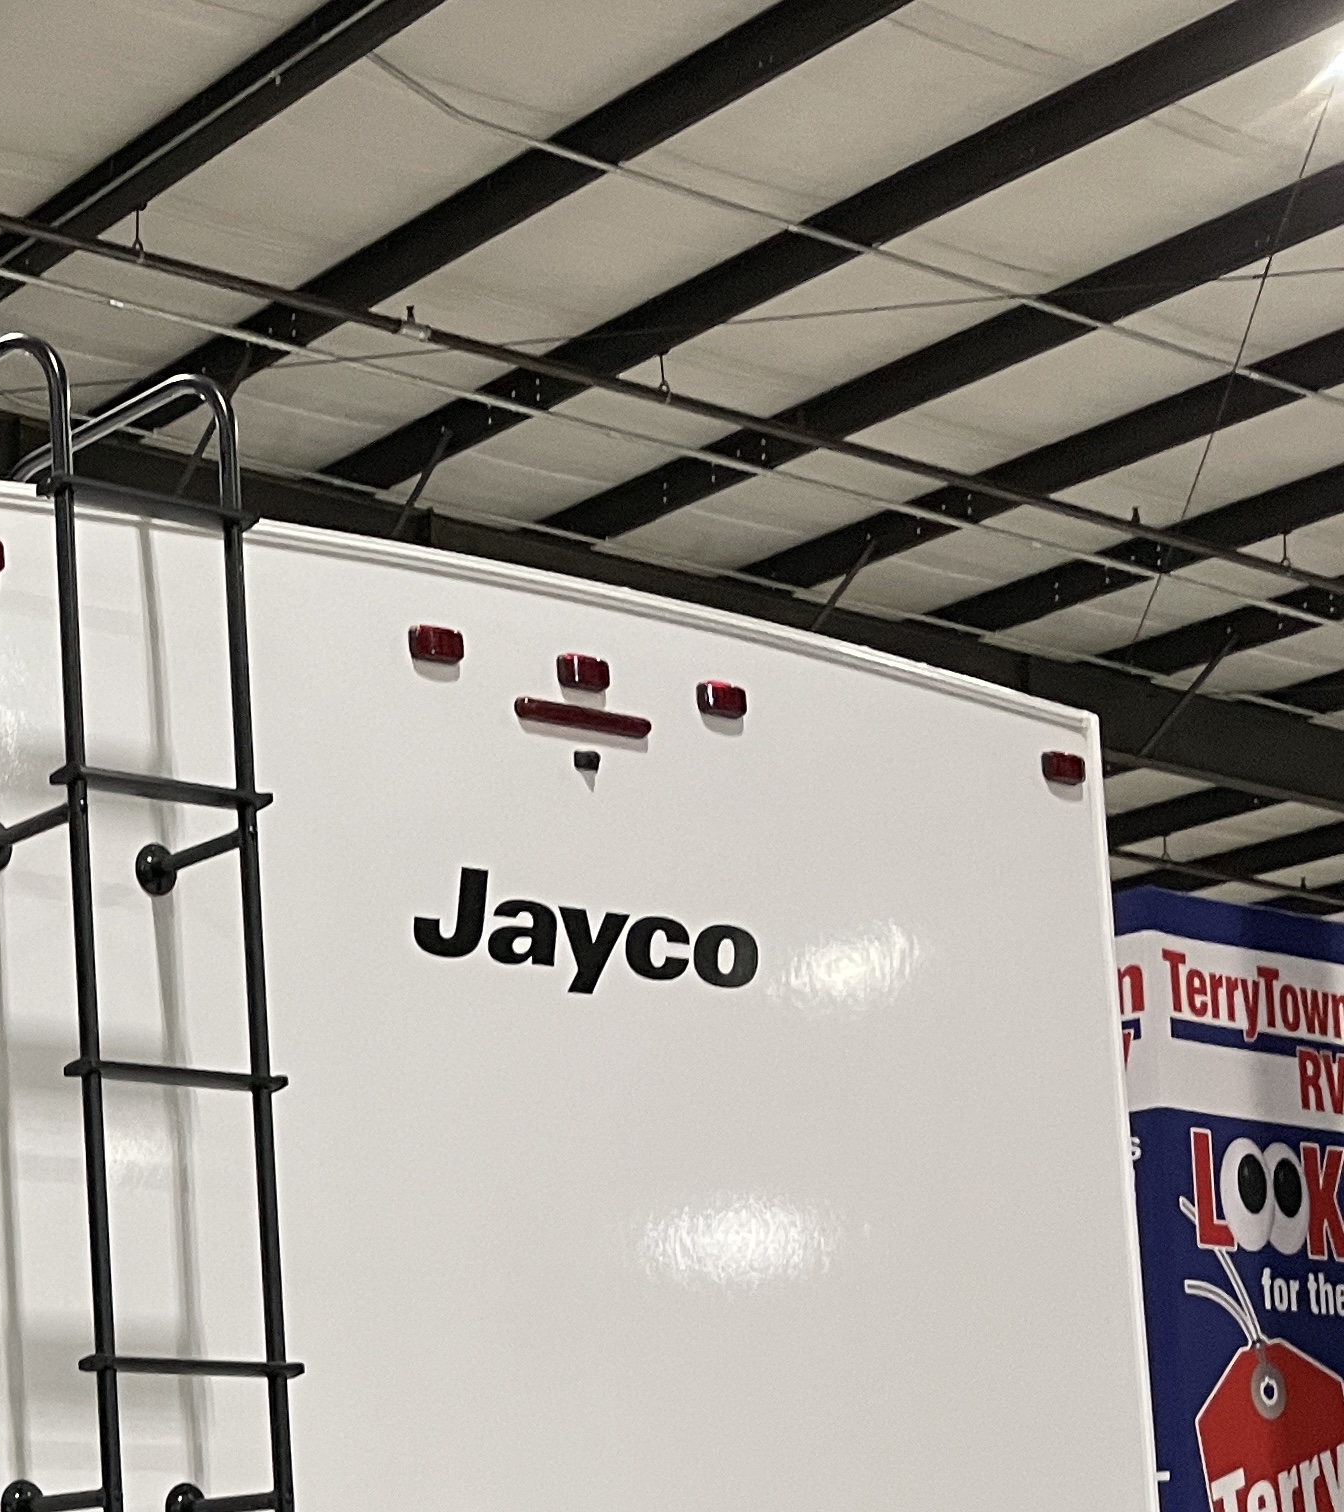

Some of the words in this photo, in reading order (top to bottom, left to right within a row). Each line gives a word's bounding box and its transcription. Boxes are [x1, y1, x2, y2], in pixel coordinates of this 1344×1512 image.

[413, 866, 759, 995] Jayco
[1296, 1046, 1344, 1115] RV
[1262, 1266, 1301, 1312] for
[1308, 1272, 1344, 1316] the
